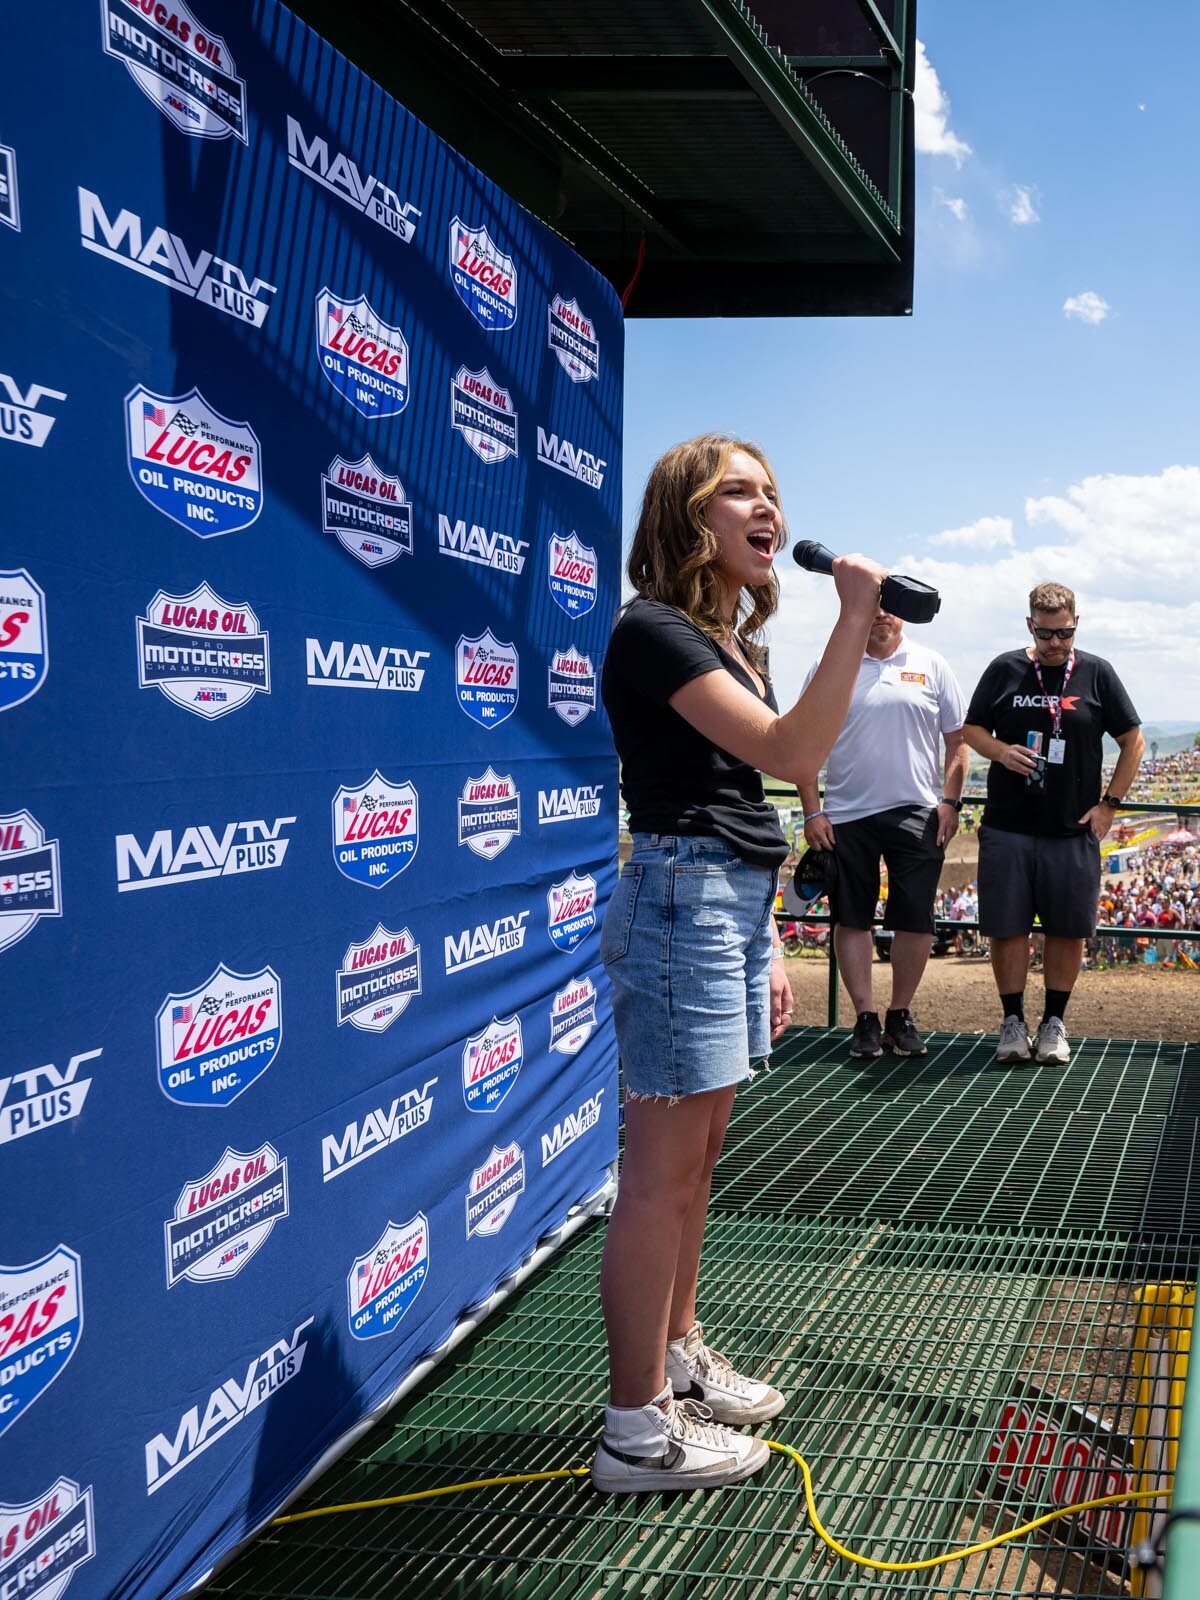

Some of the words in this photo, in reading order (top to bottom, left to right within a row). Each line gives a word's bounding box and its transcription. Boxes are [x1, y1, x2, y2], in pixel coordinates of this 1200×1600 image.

[110, 12, 241, 116] MOTOCROSS
[195, 34, 222, 66] OIL
[375, 202, 406, 238] PLUS
[458, 250, 511, 296] LUCAS
[212, 278, 254, 322] PLUS
[455, 273, 470, 290] OIL
[472, 284, 513, 319] PRODUCTS
[328, 327, 401, 376] LUCAS
[366, 332, 403, 354] PERFORMANCE
[324, 356, 344, 374] OIL
[348, 366, 403, 401] PRODUCTS
[463, 376, 492, 402] LUCAS
[494, 392, 506, 410] OIL
[455, 400, 515, 439] MOTOCROSS
[145, 431, 251, 482] LUCAS
[201, 430, 254, 454] PERFORMANCE
[139, 468, 168, 489] OIL
[173, 477, 255, 511] PRODUCTS
[338, 467, 377, 495] LUCAS
[380, 481, 397, 501] OIL
[581, 468, 598, 486] PLUS
[327, 498, 408, 534] MOTOCROSS
[497, 552, 518, 572] PLUS
[555, 558, 594, 584] LUCAS
[552, 580, 563, 592] OIL
[563, 583, 594, 600] PRODUCTS
[162, 604, 217, 632] LUCAS
[222, 611, 247, 633] OIL
[145, 645, 264, 670] MOTOCROSS
[192, 640, 223, 650] PRO
[146, 664, 264, 677] CHAMPIONSHIP
[388, 670, 416, 688] PLUS
[464, 662, 514, 686] LUCAS
[557, 658, 577, 674] LUCAS
[578, 661, 588, 674] OIL
[194, 691, 216, 702] AMA
[461, 690, 474, 701] OIL
[476, 691, 515, 704] PRODUCTS
[550, 682, 594, 696] MOTOCROSS
[379, 800, 413, 808] PERFORMANCE
[469, 784, 496, 800] LUCAS
[497, 783, 510, 797] OIL
[580, 801, 596, 814] PLUS
[344, 808, 411, 841] LUCAS
[462, 809, 518, 827] MOTOCROSS
[236, 844, 276, 870] PLUS
[340, 850, 358, 863] OIL
[361, 841, 413, 860] PRODUCTS
[554, 893, 593, 923] LUCAS
[500, 930, 520, 950] PLUS
[552, 928, 563, 939] OIL
[563, 915, 593, 934] PRODUCTS
[352, 943, 388, 970] LUCAS
[390, 938, 406, 957] OIL
[225, 987, 274, 1008] PERFORMANCE
[342, 965, 417, 1004] MOTOCROSS
[342, 978, 417, 1009] CHAMPIONSHIP
[174, 999, 272, 1062] LUCAS
[168, 1068, 195, 1088] OIL
[200, 1037, 275, 1077] PRODUCTS
[470, 1037, 517, 1083] LUCAS
[468, 1087, 481, 1101] OIL
[482, 1063, 519, 1093] PRODUCTS
[10, 1090, 72, 1135] PLUS
[398, 1105, 426, 1135] PLUS
[580, 1109, 597, 1130] PLUS
[188, 1168, 240, 1214] LUCAS
[243, 1155, 266, 1183] OIL
[476, 1159, 502, 1190] LUCAS
[503, 1150, 515, 1169] OIL
[216, 1197, 245, 1216] PRO
[469, 1168, 522, 1220] MOTOCROSS
[173, 1183, 283, 1259] MOTOCROSS
[173, 1200, 283, 1267] CHAMPIONSHIP
[391, 1227, 424, 1255] PERFORMANCE
[359, 1236, 422, 1308] LUCAS
[0, 1269, 70, 1312] ERFORMANCE
[355, 1310, 372, 1330] OIL
[375, 1266, 425, 1314] PRODUCTS
[257, 1355, 295, 1400] PLUS
[25, 1494, 60, 1540] OIL
